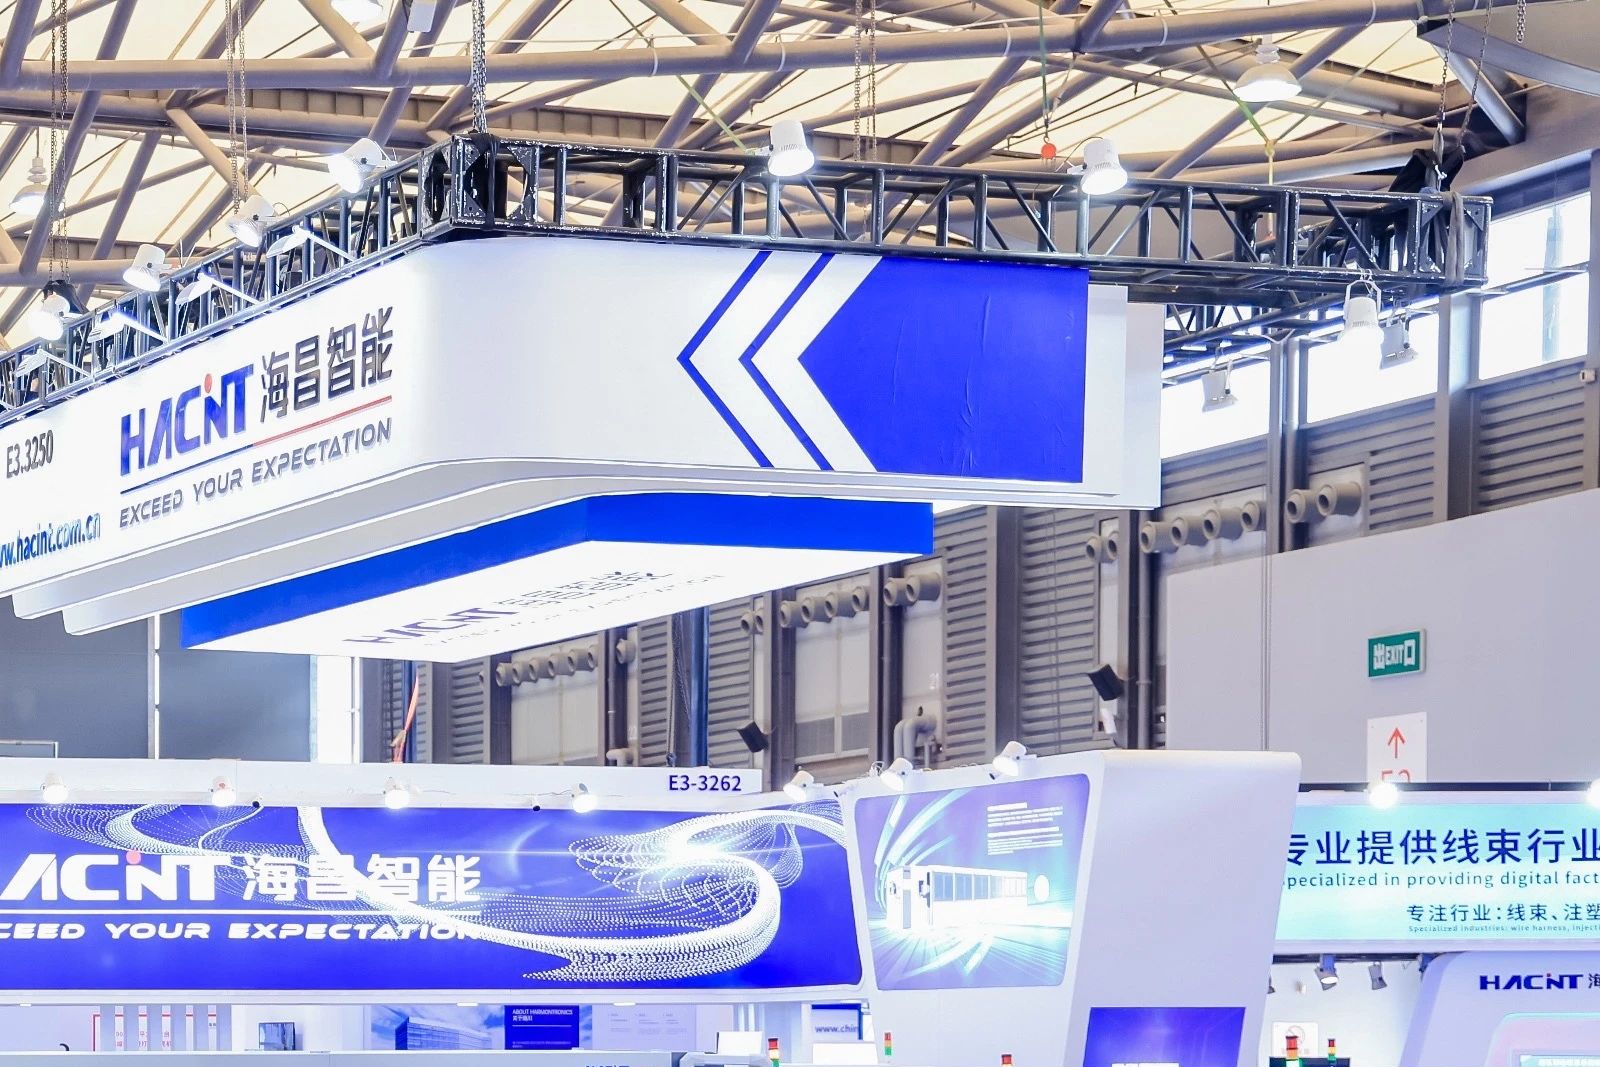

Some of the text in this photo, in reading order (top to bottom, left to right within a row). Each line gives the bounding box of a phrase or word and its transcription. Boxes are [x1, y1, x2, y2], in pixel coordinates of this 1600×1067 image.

[260, 306, 394, 424] 海昌智能
[5, 429, 55, 479] E3.3250
[119, 416, 393, 529] EXCEED YOUR EXPECTATION
[668, 774, 742, 793] E3-3262
[242, 853, 482, 903] 海昌智能
[1283, 872, 1378, 890] pecialized
[1384, 872, 1401, 886] in
[1406, 871, 1495, 889] providing
[1499, 870, 1559, 889] digital
[105, 922, 211, 940] YOUR
